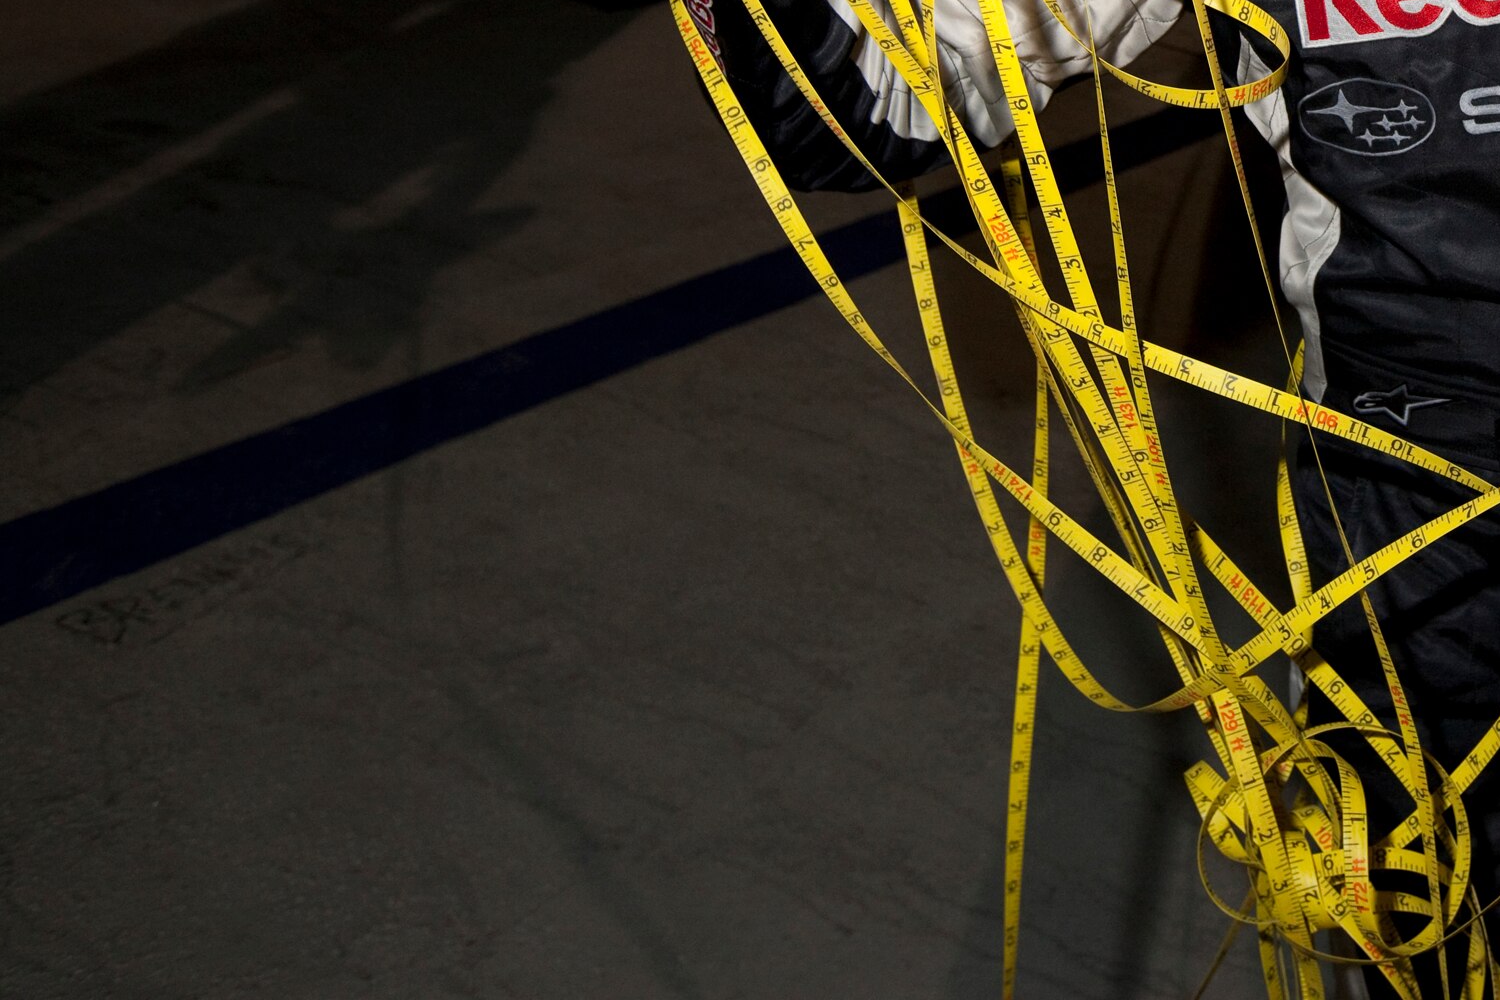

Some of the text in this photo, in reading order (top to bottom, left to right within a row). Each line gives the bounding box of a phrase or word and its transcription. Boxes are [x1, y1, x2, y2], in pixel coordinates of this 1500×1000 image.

[1238, 7, 1250, 22] 8
[681, 20, 710, 67] 175 ft
[1234, 87, 1247, 100] ft
[726, 105, 748, 129] 10
[777, 198, 793, 212] 8
[798, 238, 814, 252] 7
[987, 212, 1020, 263] 128 ft
[1113, 386, 1138, 430] 143 ft
[1316, 409, 1338, 429] 90
[1391, 438, 1415, 457] 10
[993, 464, 1034, 501] 174 ft
[1154, 473, 1167, 486] ft
[1230, 572, 1265, 614] 113 ft
[1217, 701, 1246, 751] 129 ft
[1352, 857, 1369, 914] 172 ft
